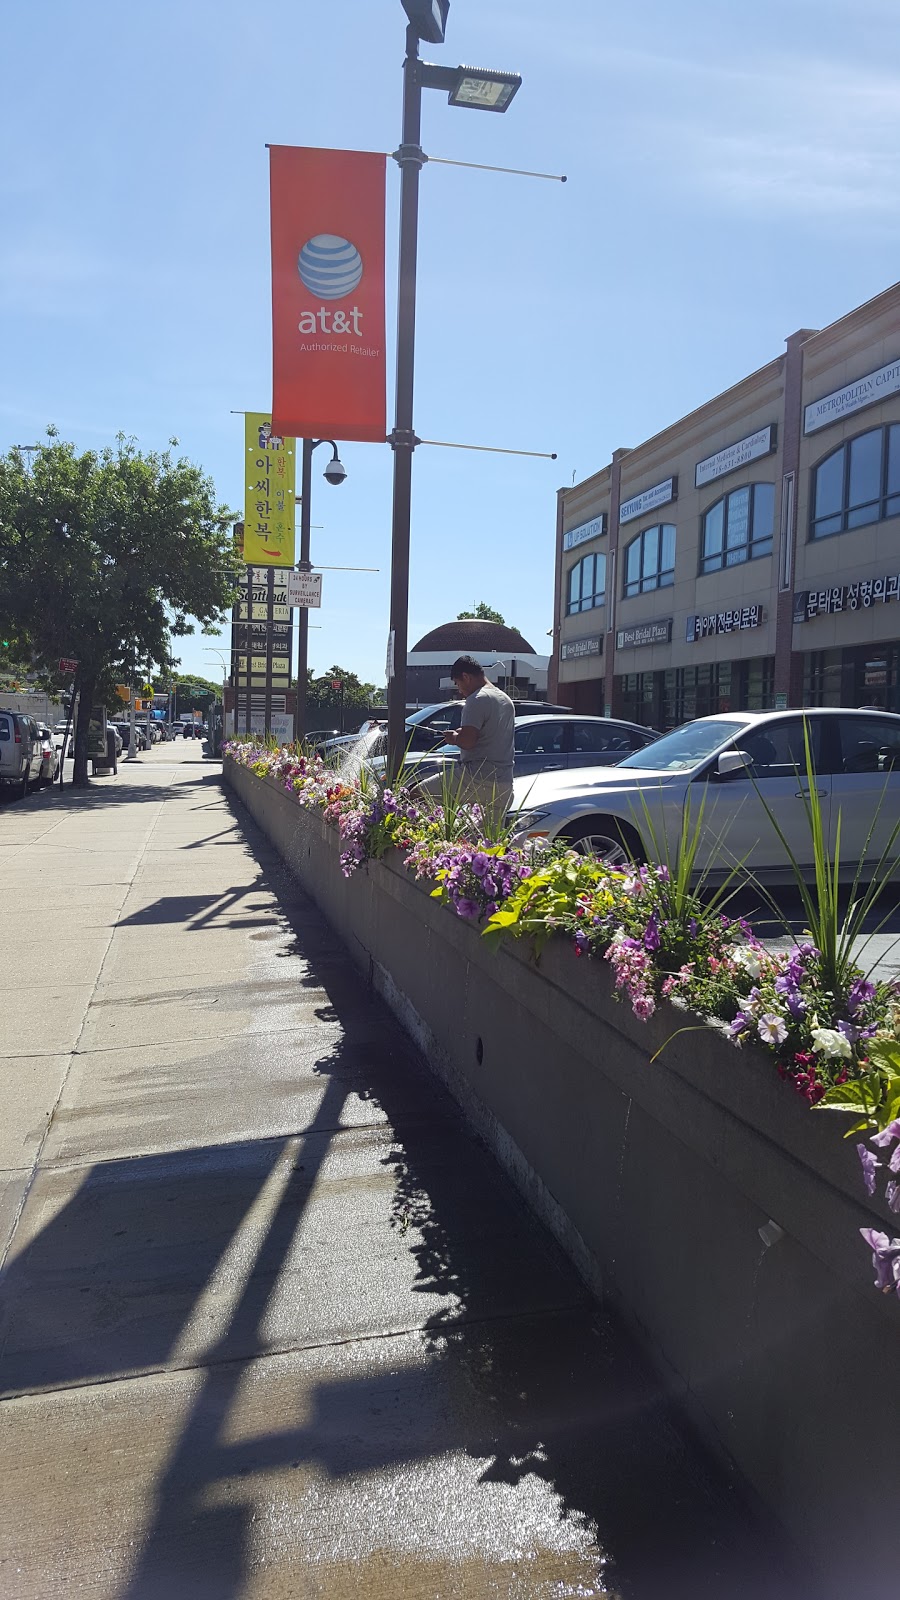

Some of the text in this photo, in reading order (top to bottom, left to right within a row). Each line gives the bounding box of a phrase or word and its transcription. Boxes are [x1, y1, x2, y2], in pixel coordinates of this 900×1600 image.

[298, 306, 363, 337] at&t
[300, 342, 380, 357] Authorized Retailer
[816, 379, 874, 416] METROPOLITAN
[699, 457, 716, 473] Internal
[716, 449, 736, 465] Medicine
[741, 432, 768, 451] Cardiology
[276, 456, 287, 479] 한복
[254, 455, 273, 542] 아씨한복
[275, 489, 286, 512] 이불
[580, 520, 601, 540] SOLUTION
[290, 590, 320, 598] SURVEILLANCE
[806, 586, 844, 618] 문태원
[694, 605, 760, 638] 레이저 전문의료원
[624, 632, 635, 643] Best
[635, 627, 651, 639] Bridal
[652, 626, 667, 638] Plaza
[567, 645, 576, 654] Best
[576, 643, 588, 653] Bridal
[588, 640, 599, 650] Plaza
